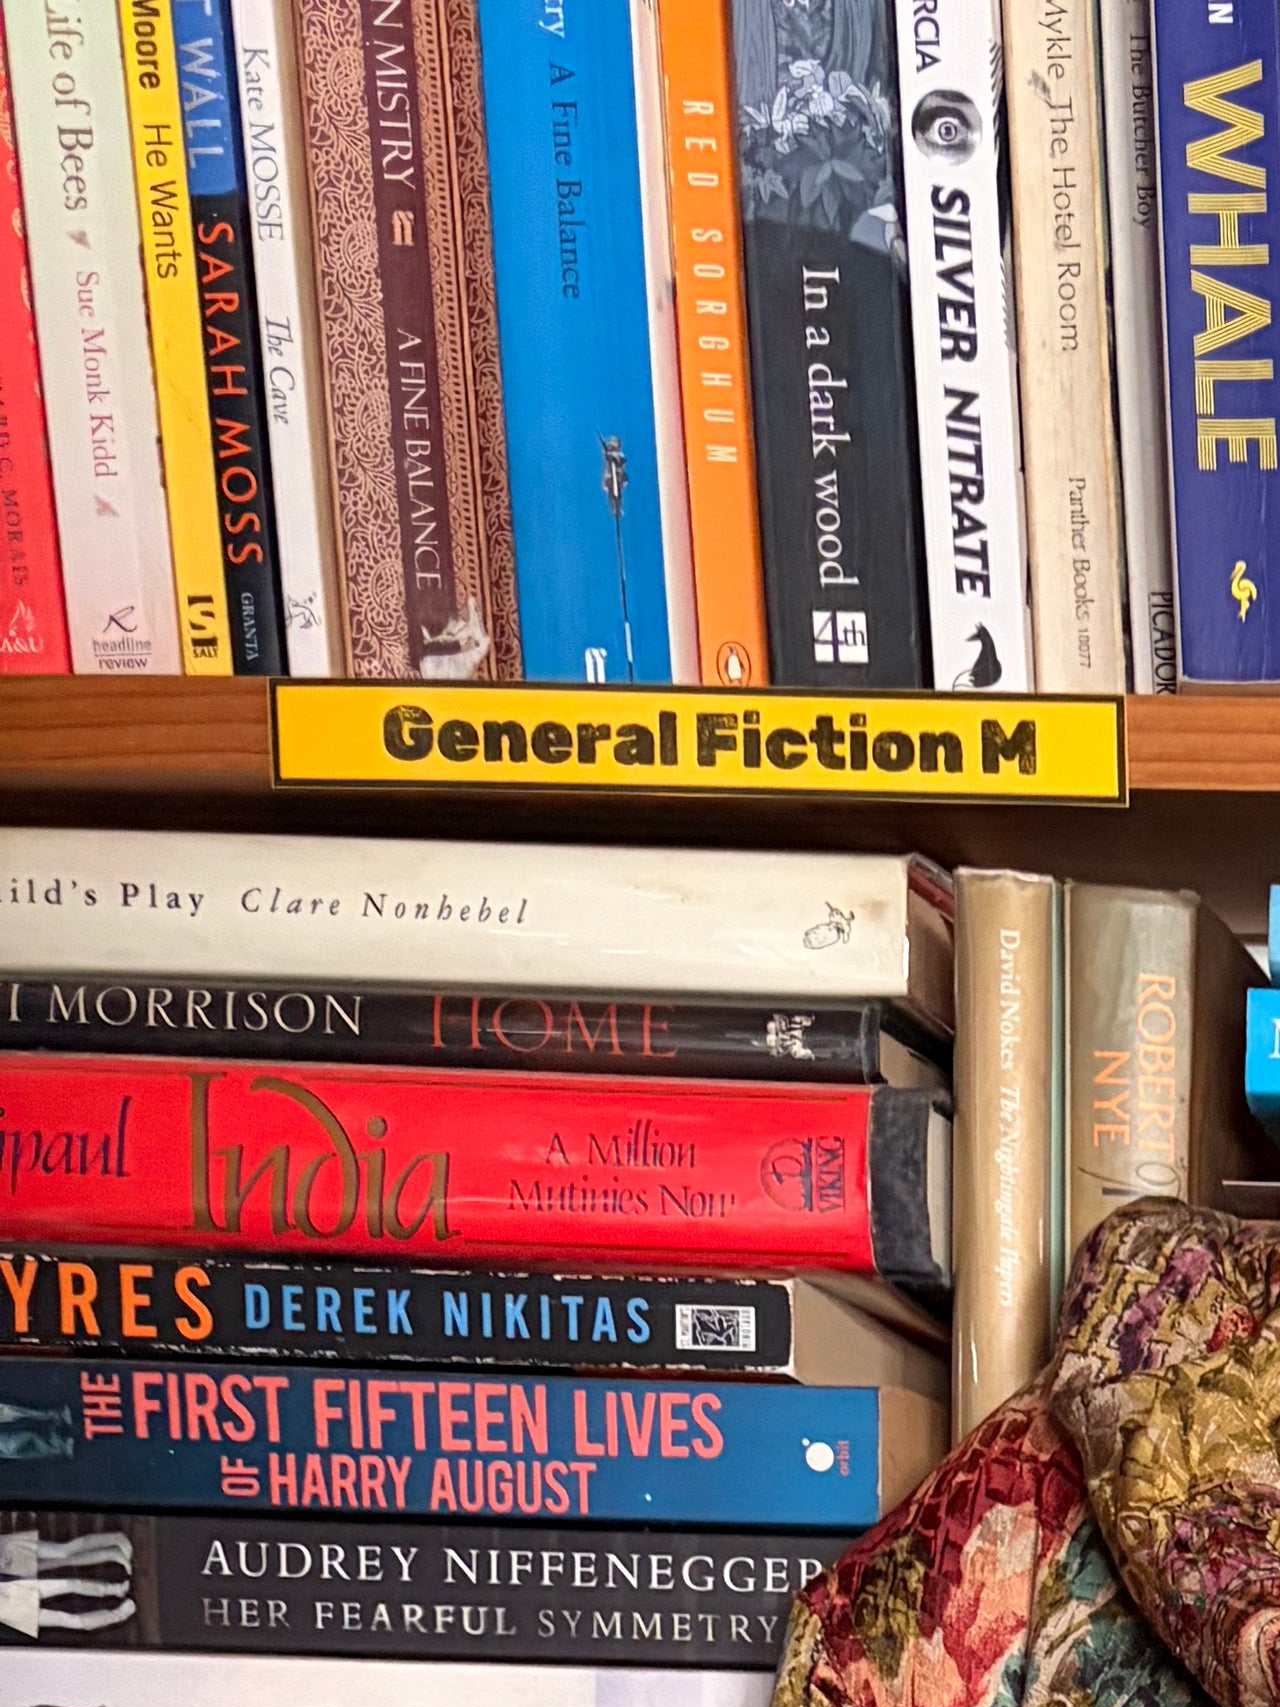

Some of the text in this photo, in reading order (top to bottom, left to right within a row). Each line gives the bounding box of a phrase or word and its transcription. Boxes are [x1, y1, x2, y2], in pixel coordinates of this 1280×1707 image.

[242, 47, 290, 426] Kate MOSSE The Cave
[1182, 60, 1278, 472] WHALE
[683, 100, 739, 464] RED SORGHUM
[198, 221, 262, 565] SARAH MOSS
[802, 268, 860, 588] In a dark wood
[931, 185, 990, 598] SILVER NITRATE
[382, 706, 1038, 775] General Fiction M
[120, 882, 531, 927] Play Clare Nonhebel
[48, 986, 364, 1036] MORRISON
[244, 1283, 652, 1344] DEREK NIKITAS
[83, 1372, 723, 1458] THE FIRST FIFTEEN LIVES
[221, 1454, 599, 1516] OF HARRY AUGUST
[201, 1539, 422, 1584] AUDREY
[203, 1598, 779, 1644] HER FEARFUL SYMMETRY
